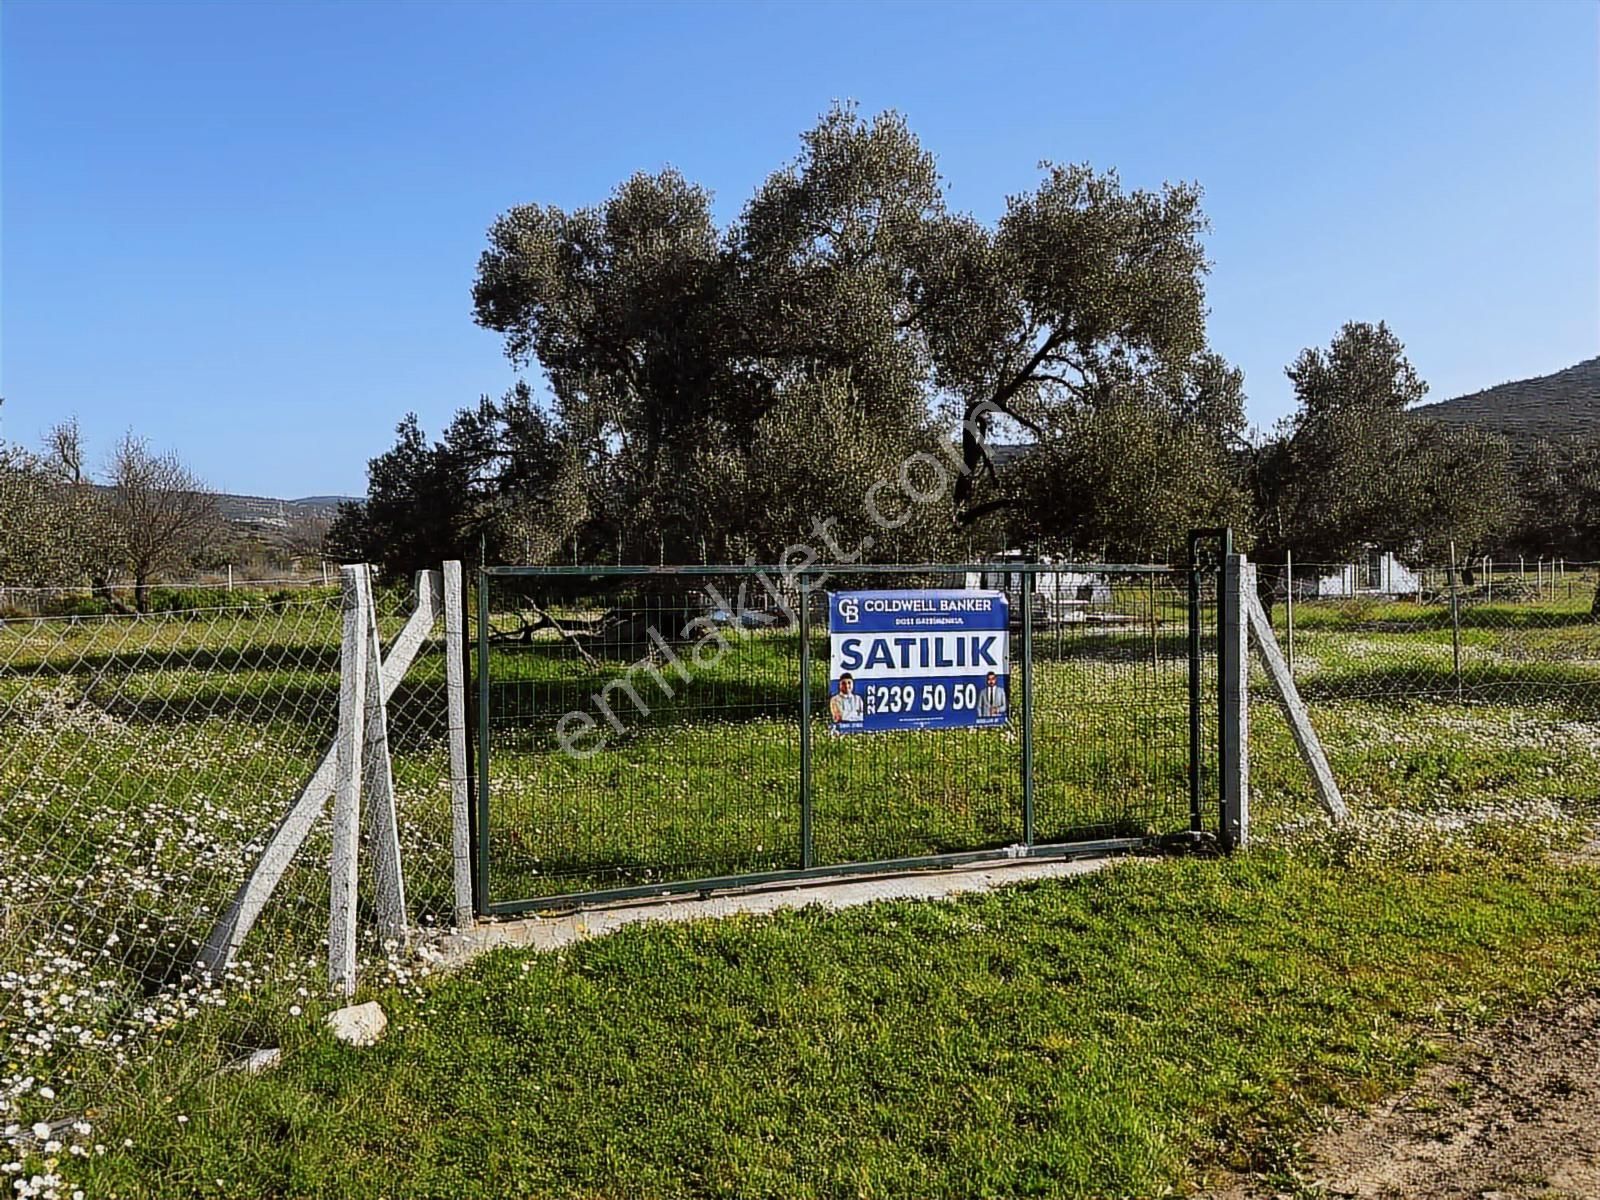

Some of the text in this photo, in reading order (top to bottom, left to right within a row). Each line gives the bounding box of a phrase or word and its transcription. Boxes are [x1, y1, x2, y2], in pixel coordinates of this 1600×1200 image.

[864, 599, 992, 612] COLDWELL BANKER
[840, 636, 998, 671] SATILIK
[876, 683, 977, 713] 239 50 50
